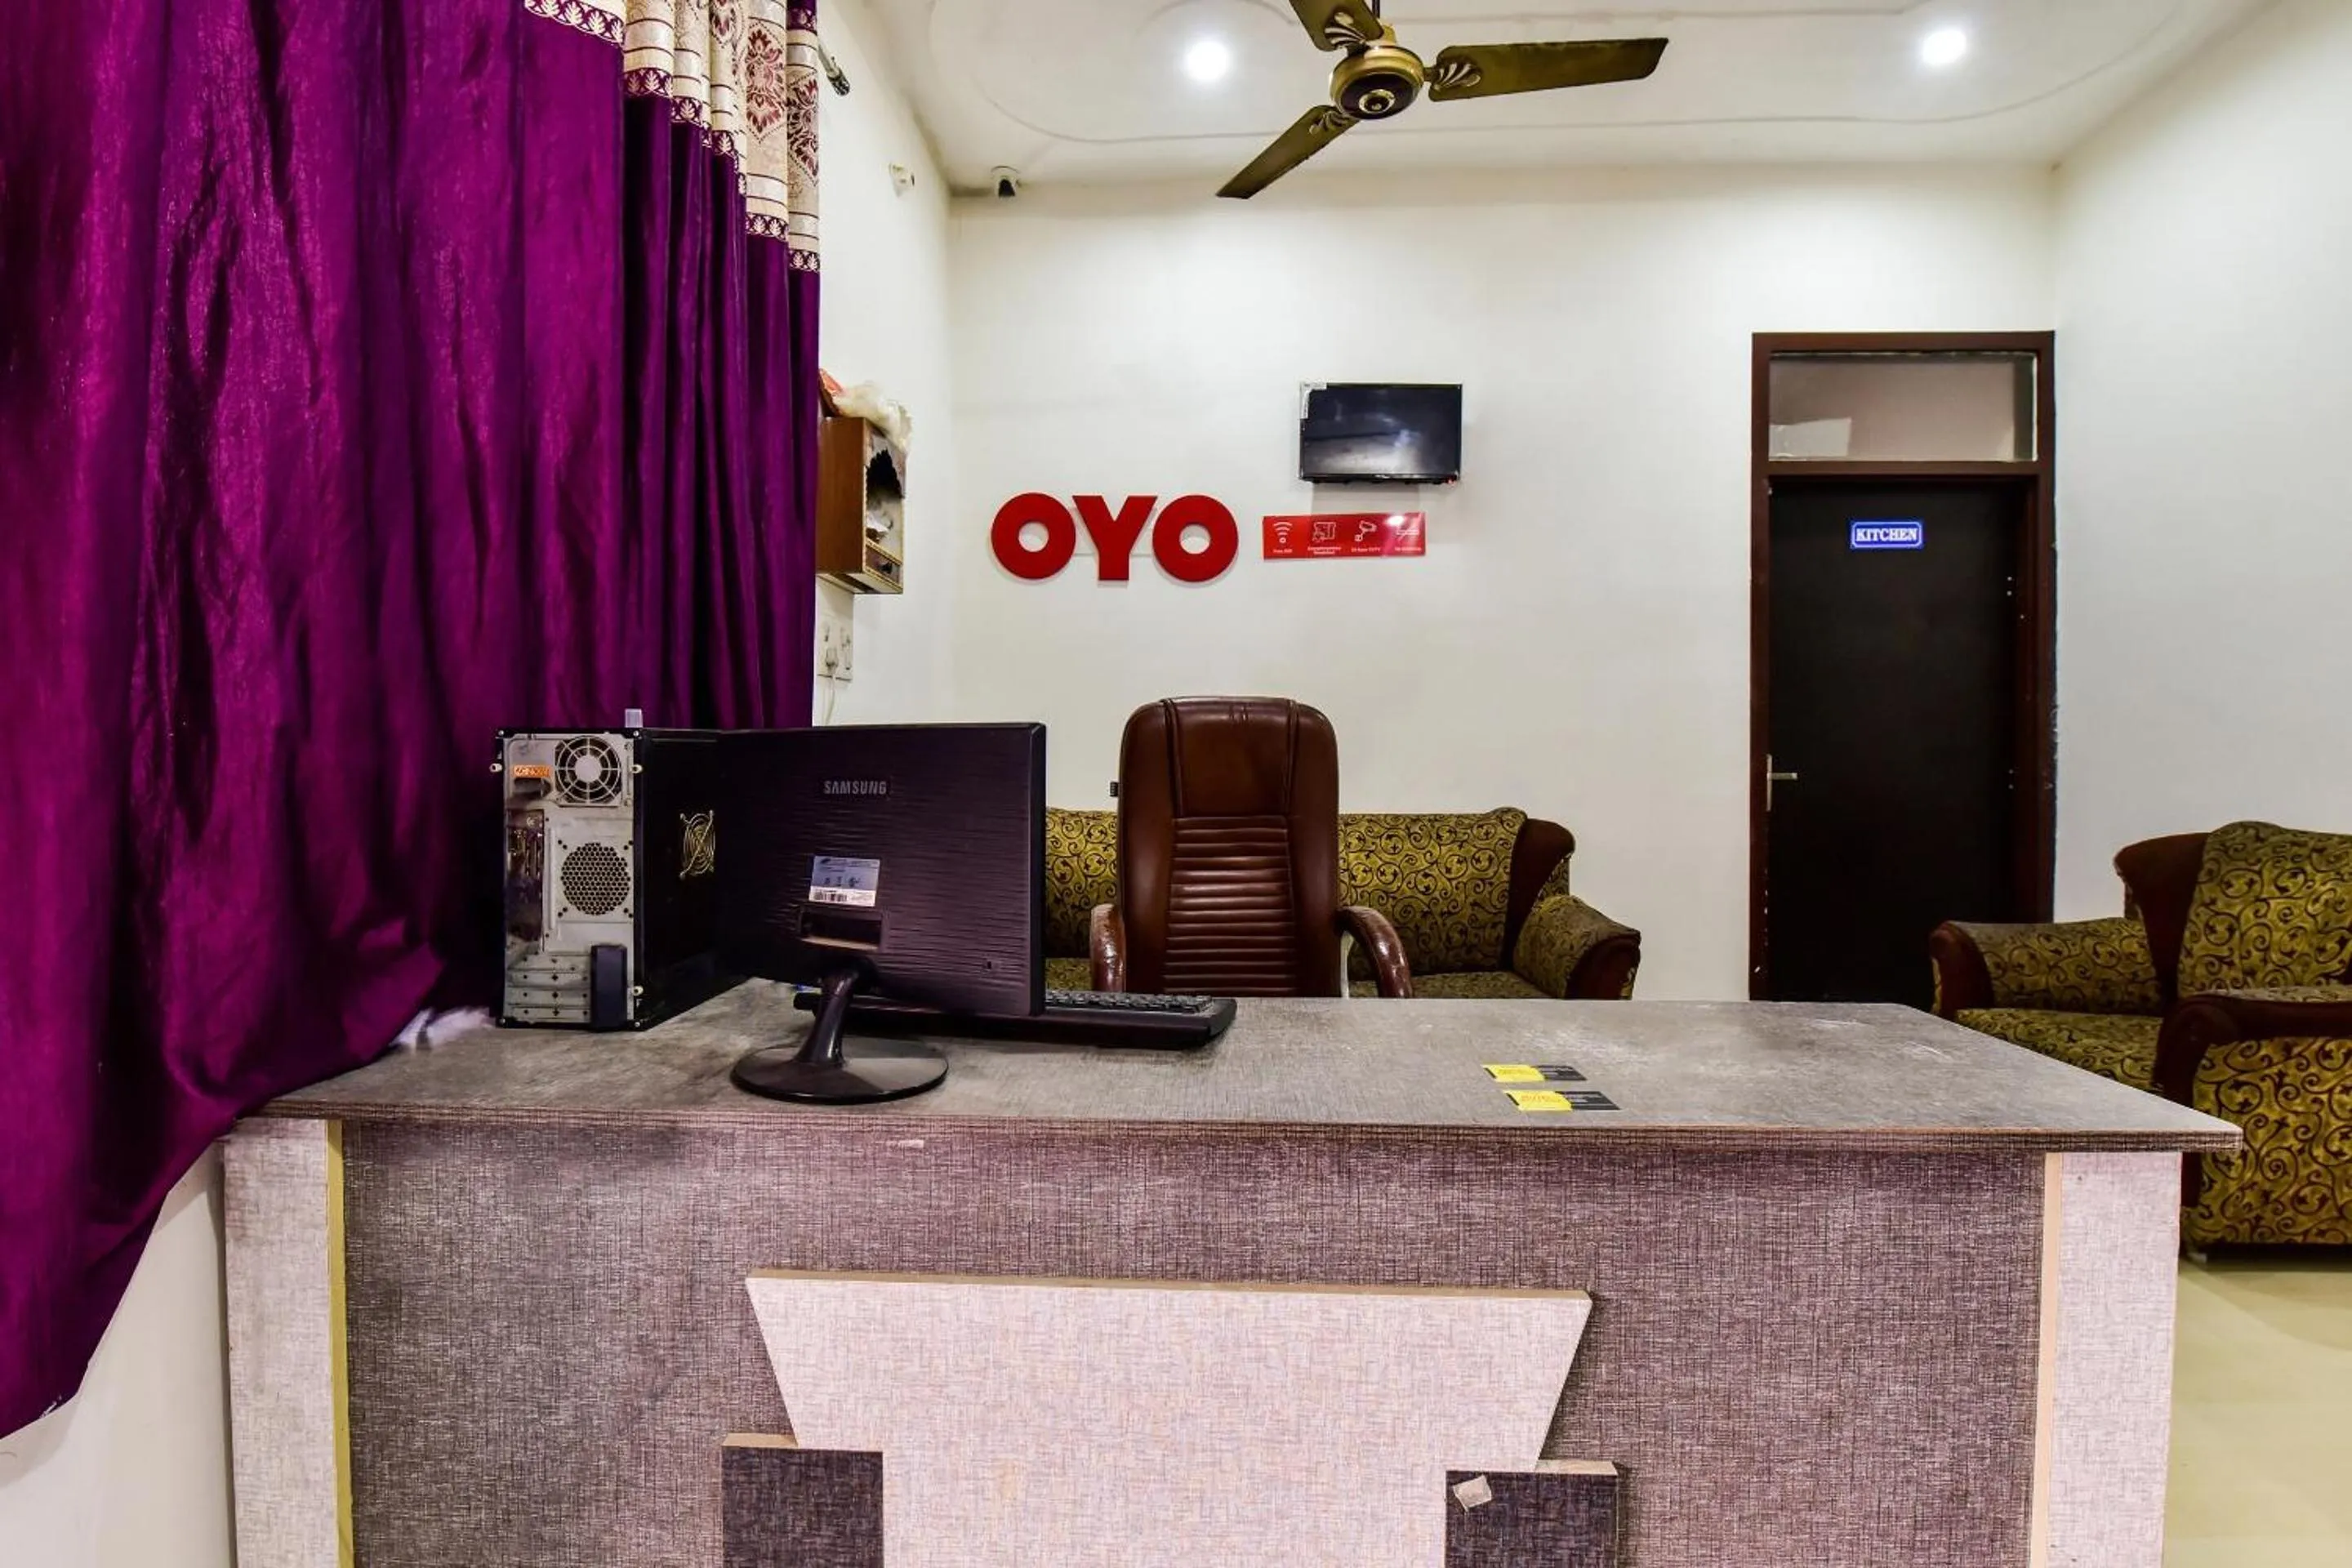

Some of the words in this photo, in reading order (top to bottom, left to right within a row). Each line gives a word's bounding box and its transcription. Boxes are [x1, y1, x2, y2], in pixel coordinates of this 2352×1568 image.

[991, 492, 1239, 582] OYO
[1855, 528, 1918, 541] KITCHEN
[822, 780, 887, 795] SAMSUNG
